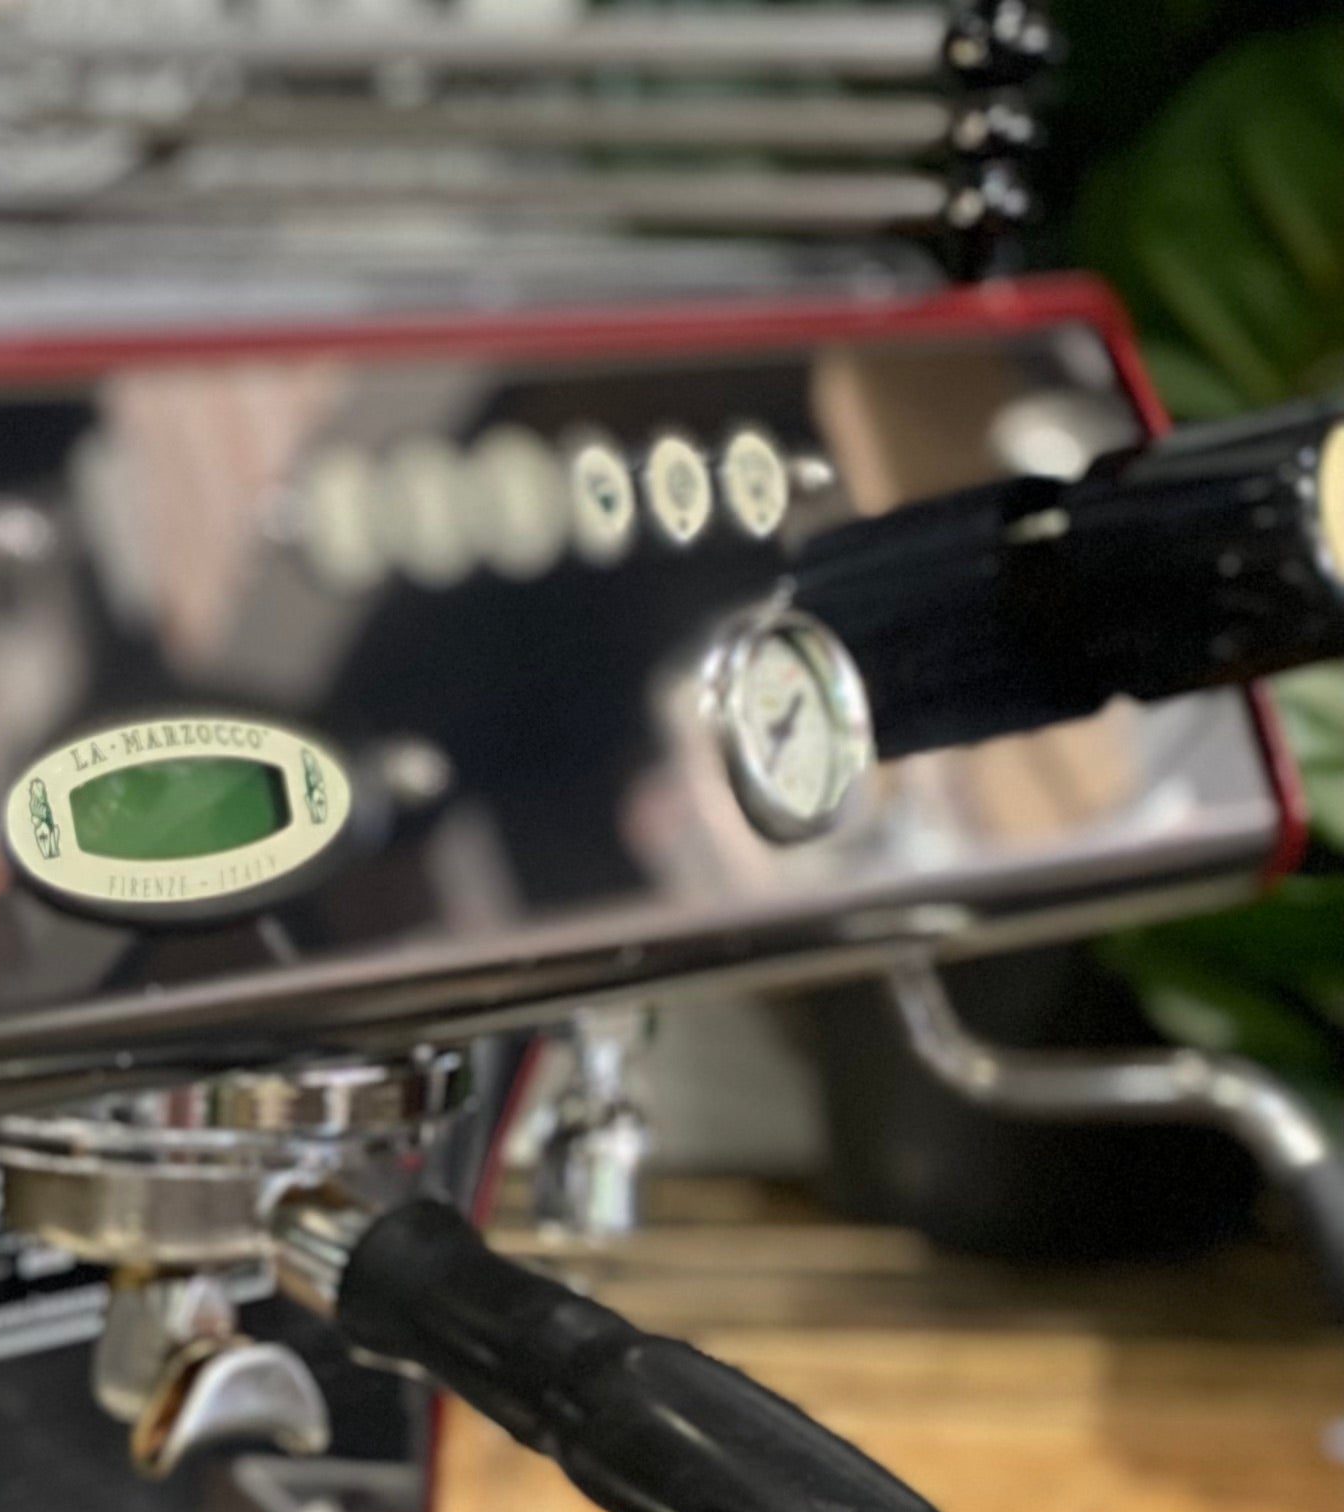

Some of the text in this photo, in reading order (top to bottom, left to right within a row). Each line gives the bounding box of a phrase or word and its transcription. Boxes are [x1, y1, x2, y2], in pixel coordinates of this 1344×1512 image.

[70, 723, 263, 772] LA MARZOCCO
[108, 874, 188, 898] FIRENZE
[218, 855, 277, 889] ITALY
